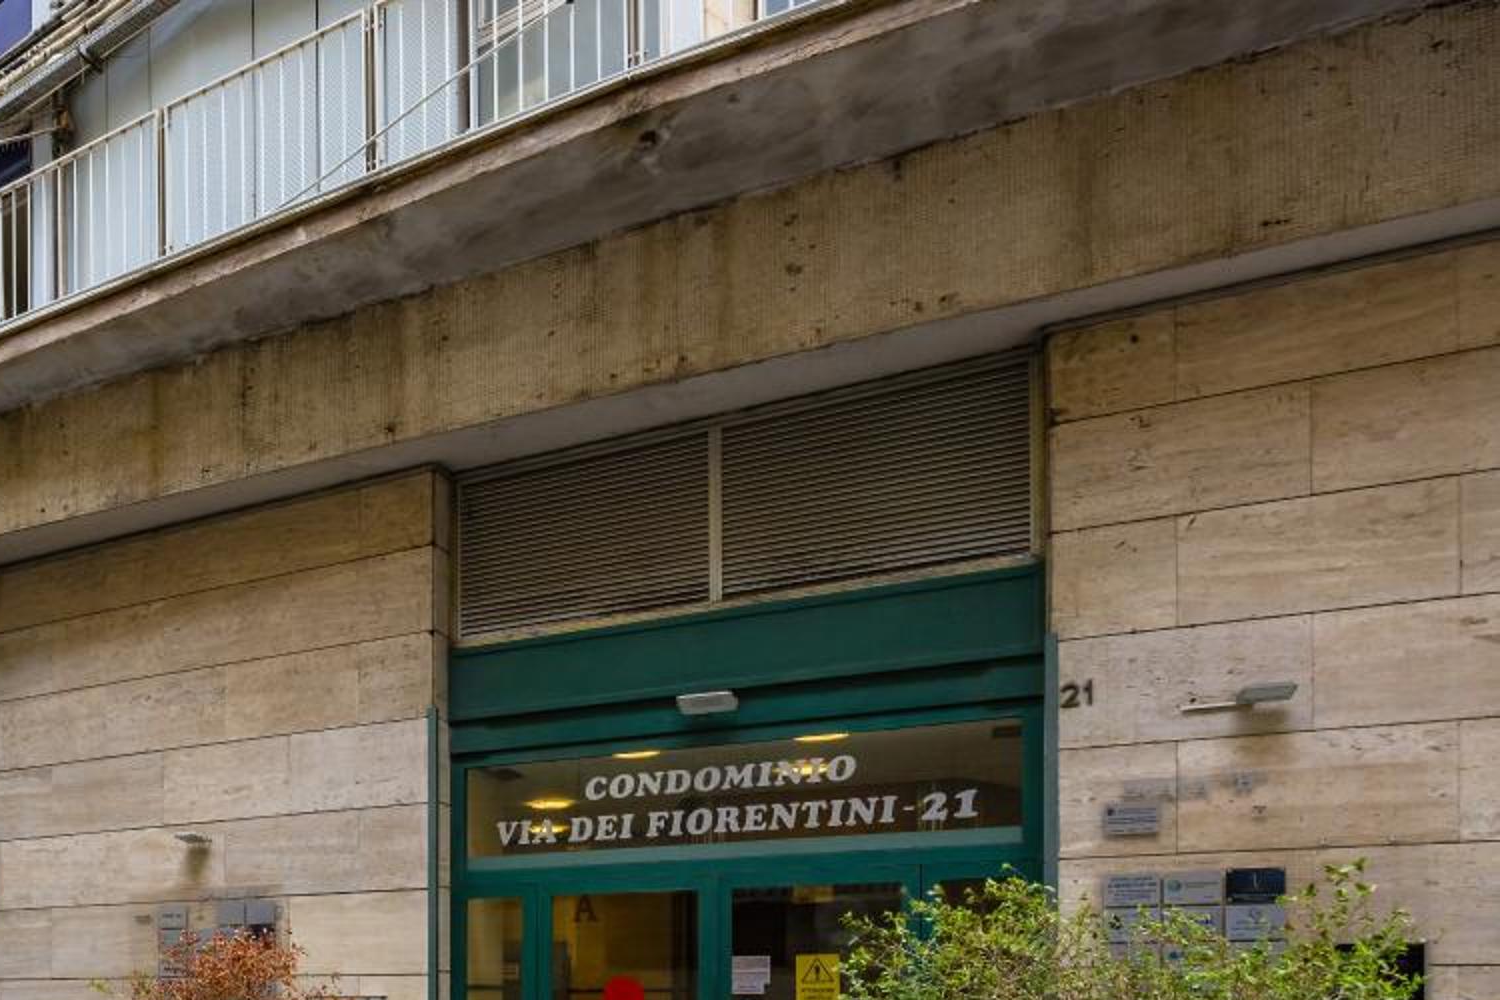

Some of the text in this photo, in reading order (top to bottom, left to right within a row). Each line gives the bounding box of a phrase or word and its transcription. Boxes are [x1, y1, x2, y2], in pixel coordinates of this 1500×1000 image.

[1059, 678, 1093, 709] 21
[585, 754, 857, 801] CONDOMINIO
[497, 818, 558, 848] VIA
[567, 812, 635, 843] DEI
